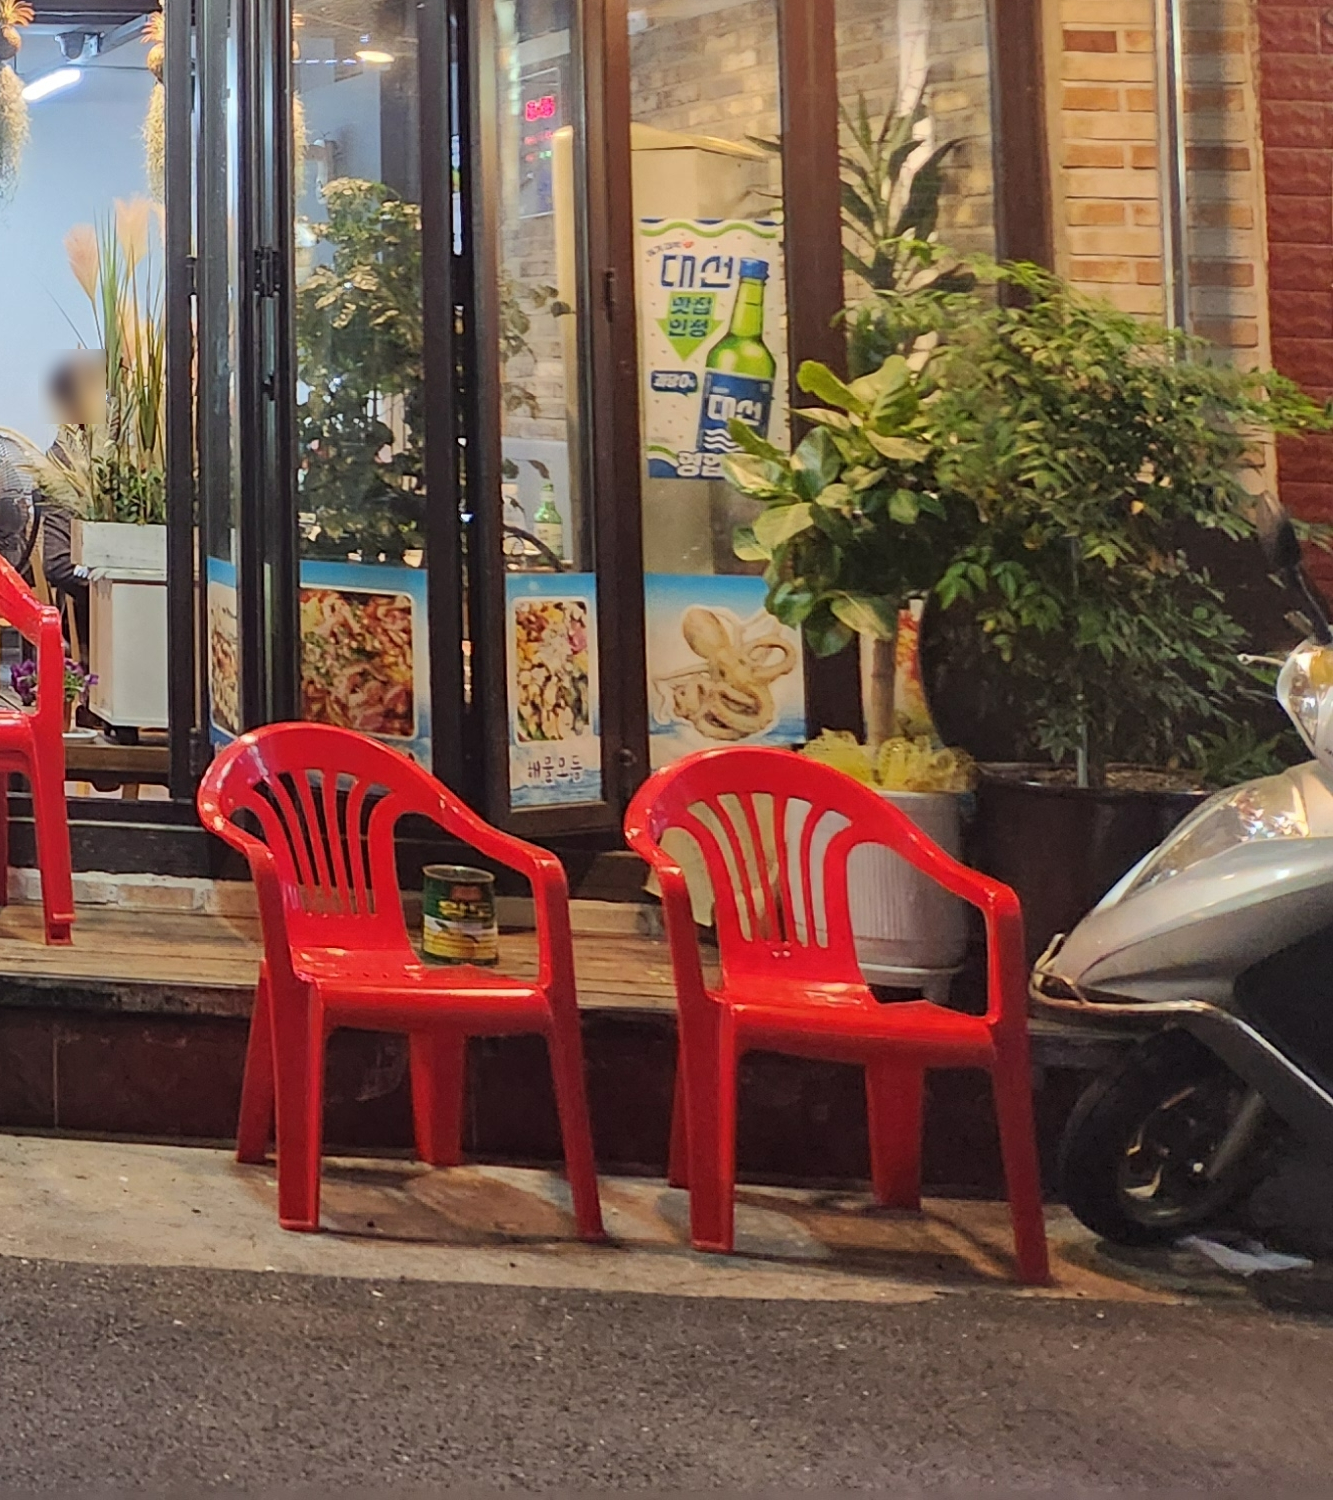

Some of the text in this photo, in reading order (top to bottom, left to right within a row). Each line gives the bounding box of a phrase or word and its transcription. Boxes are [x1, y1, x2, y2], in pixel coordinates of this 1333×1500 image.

[660, 254, 734, 289] 대선
[671, 296, 713, 316] 맛집
[668, 318, 709, 338] 인정
[528, 754, 583, 783] 해물모듬
